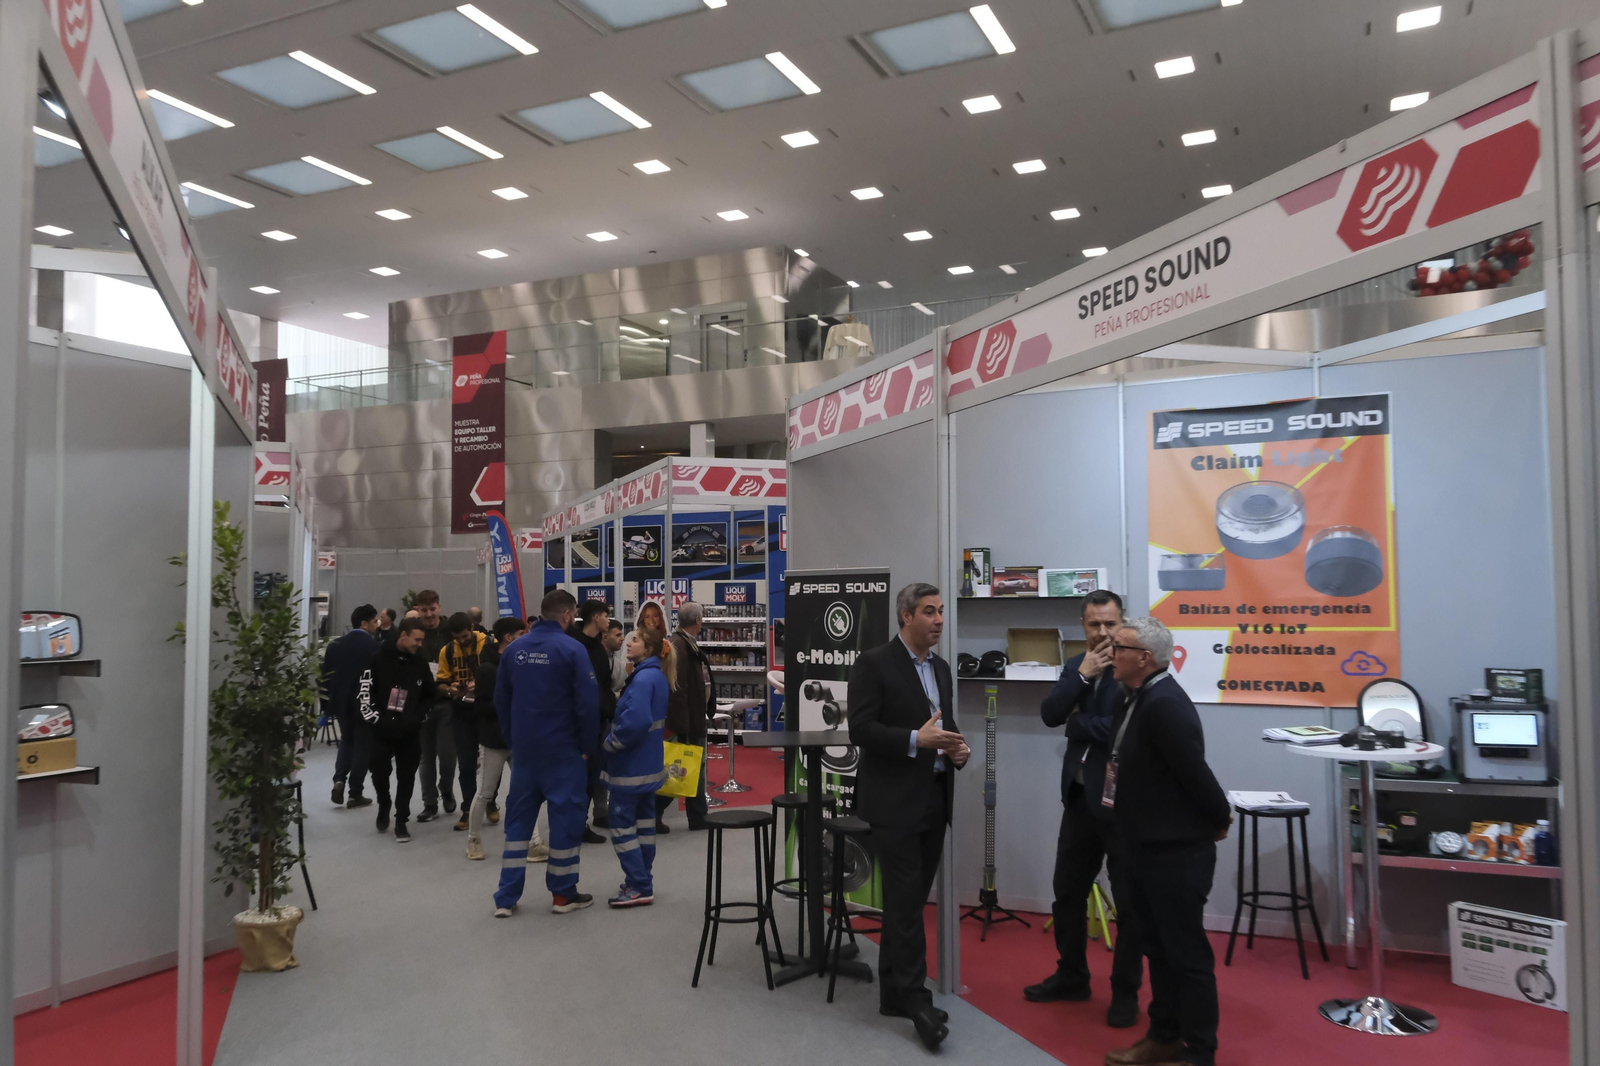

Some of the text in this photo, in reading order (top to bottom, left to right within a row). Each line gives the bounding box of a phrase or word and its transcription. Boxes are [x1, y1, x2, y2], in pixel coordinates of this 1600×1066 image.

[1078, 235, 1231, 320] SPEED SOUND
[1094, 282, 1211, 339] PEÑA PROFESIONAL
[469, 377, 501, 386] PROFESIONAL
[258, 382, 270, 430] Peña
[454, 418, 480, 427] MUESTRA
[1188, 409, 1383, 438] SPEED SOUND
[454, 425, 496, 435] EQUIPO TALLER
[459, 435, 488, 443] RECAMBIO
[463, 442, 502, 451] AUTOMOCIÓN
[1190, 447, 1344, 471] Claim Light
[802, 582, 887, 594] SPEED SOUND
[725, 594, 745, 602] MOLY
[1179, 603, 1371, 616] Baliza de emergencia
[1212, 643, 1336, 656] Geolocalizada
[1216, 679, 1326, 693] CONECTADA
[1472, 913, 1551, 935] SPEED SOUND
